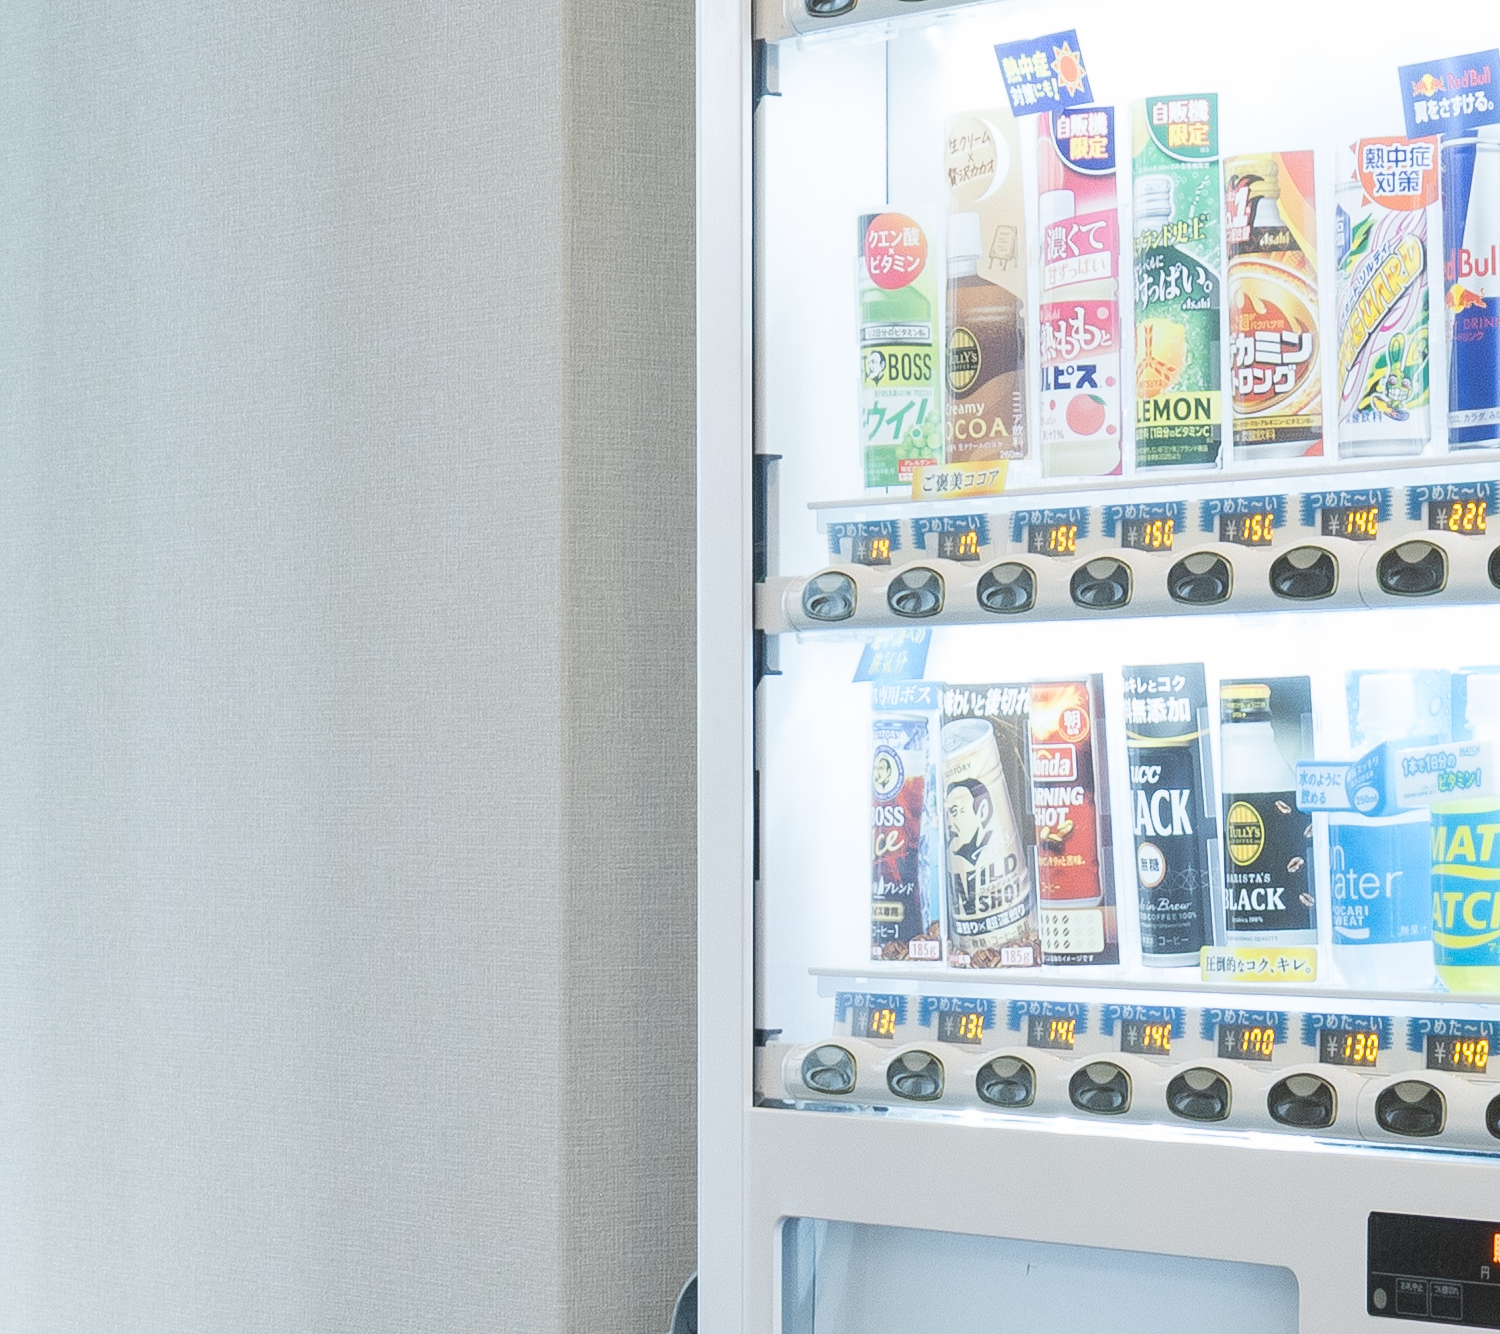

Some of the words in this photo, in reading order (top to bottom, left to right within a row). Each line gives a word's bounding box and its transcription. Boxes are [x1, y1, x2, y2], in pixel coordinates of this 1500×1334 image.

[1002, 51, 1051, 84] 熱中症
[1010, 78, 1059, 107] 対策にも!
[1152, 99, 1210, 125] 自販機
[1057, 112, 1108, 139] 自販機
[1168, 122, 1210, 148] 限定
[1069, 136, 1108, 160] 限定
[1365, 145, 1431, 169] 熱中症
[1375, 171, 1420, 194] 対策
[869, 227, 920, 249] クエン酸
[1047, 220, 1106, 260] 濃くて
[1260, 230, 1290, 247] Asahi
[870, 255, 920, 274] ビタミン
[889, 353, 932, 381] BOSS
[922, 470, 999, 493] ご褒美ココア
[1300, 771, 1341, 786] 水のように
[1438, 768, 1482, 792] ビタミン!
[1301, 791, 1326, 805] 飲める
[911, 942, 937, 958] 185g
[1005, 949, 1032, 965] 185g
[1206, 955, 1312, 975] 圧倒的なコク、キレ。
